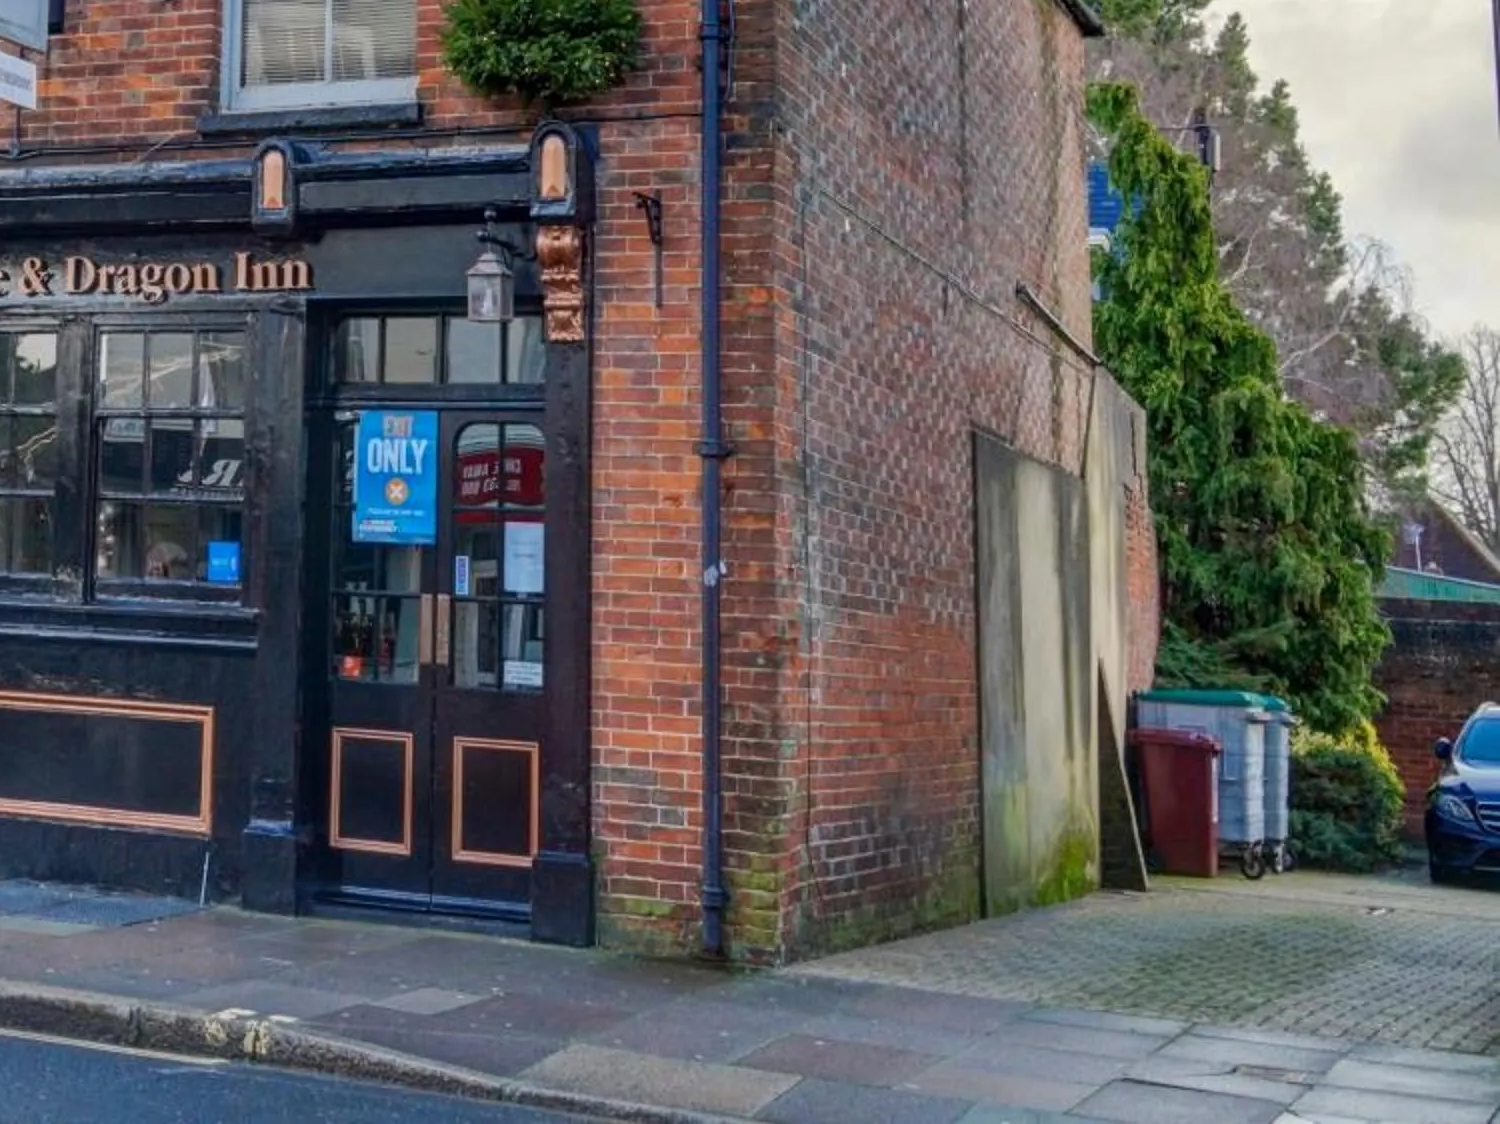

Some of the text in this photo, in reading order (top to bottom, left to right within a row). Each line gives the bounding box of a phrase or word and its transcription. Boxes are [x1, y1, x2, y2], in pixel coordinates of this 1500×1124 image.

[18, 257, 51, 295] &
[64, 255, 223, 304] Dragon
[234, 251, 313, 291] Inn
[367, 437, 428, 475] ONLY
